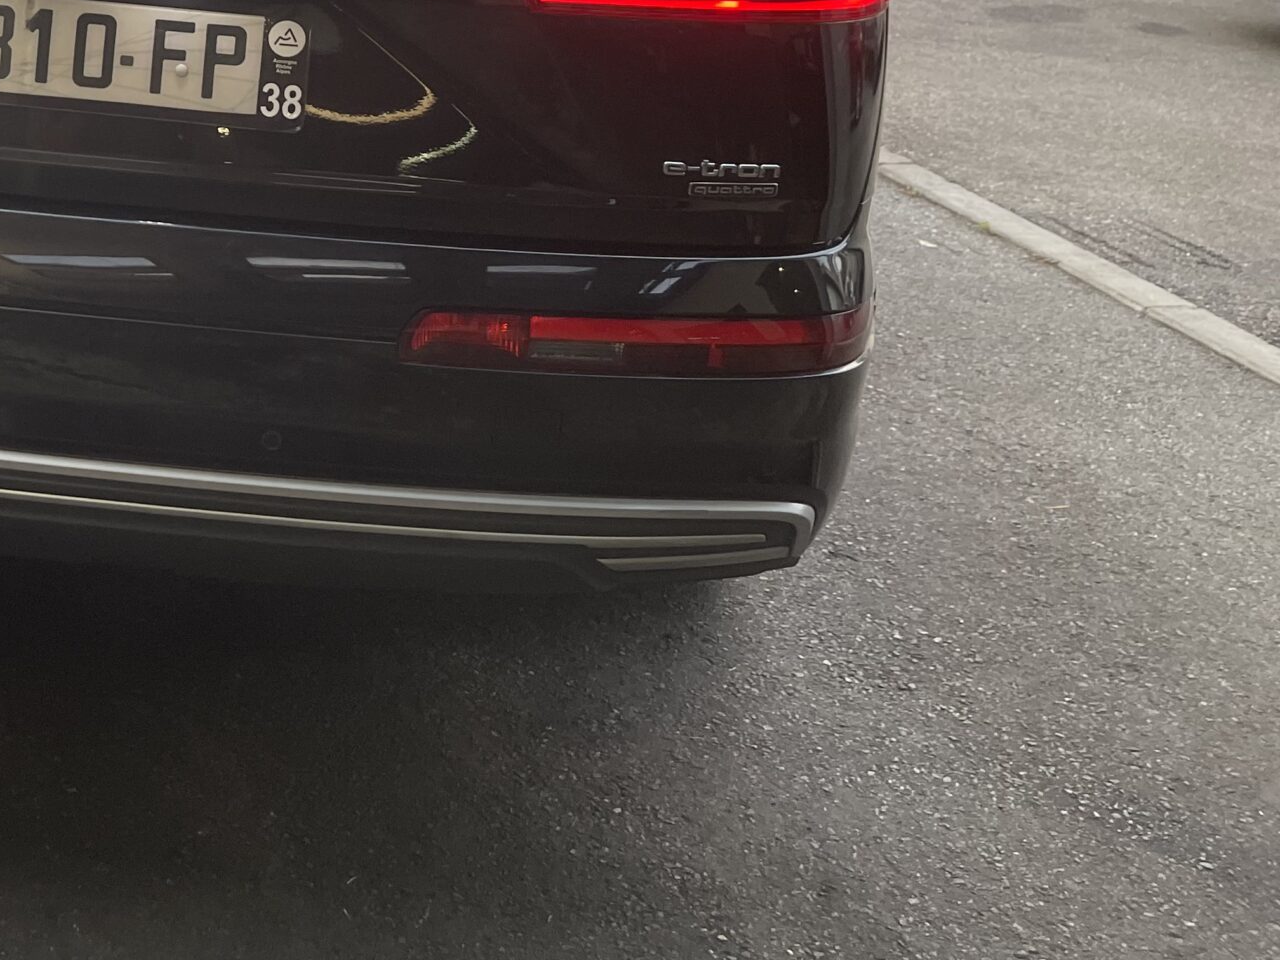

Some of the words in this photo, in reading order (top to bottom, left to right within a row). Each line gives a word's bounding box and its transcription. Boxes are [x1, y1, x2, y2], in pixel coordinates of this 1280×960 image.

[260, 82, 302, 120] 38
[662, 159, 781, 178] e-tron
[693, 184, 775, 195] quattro
